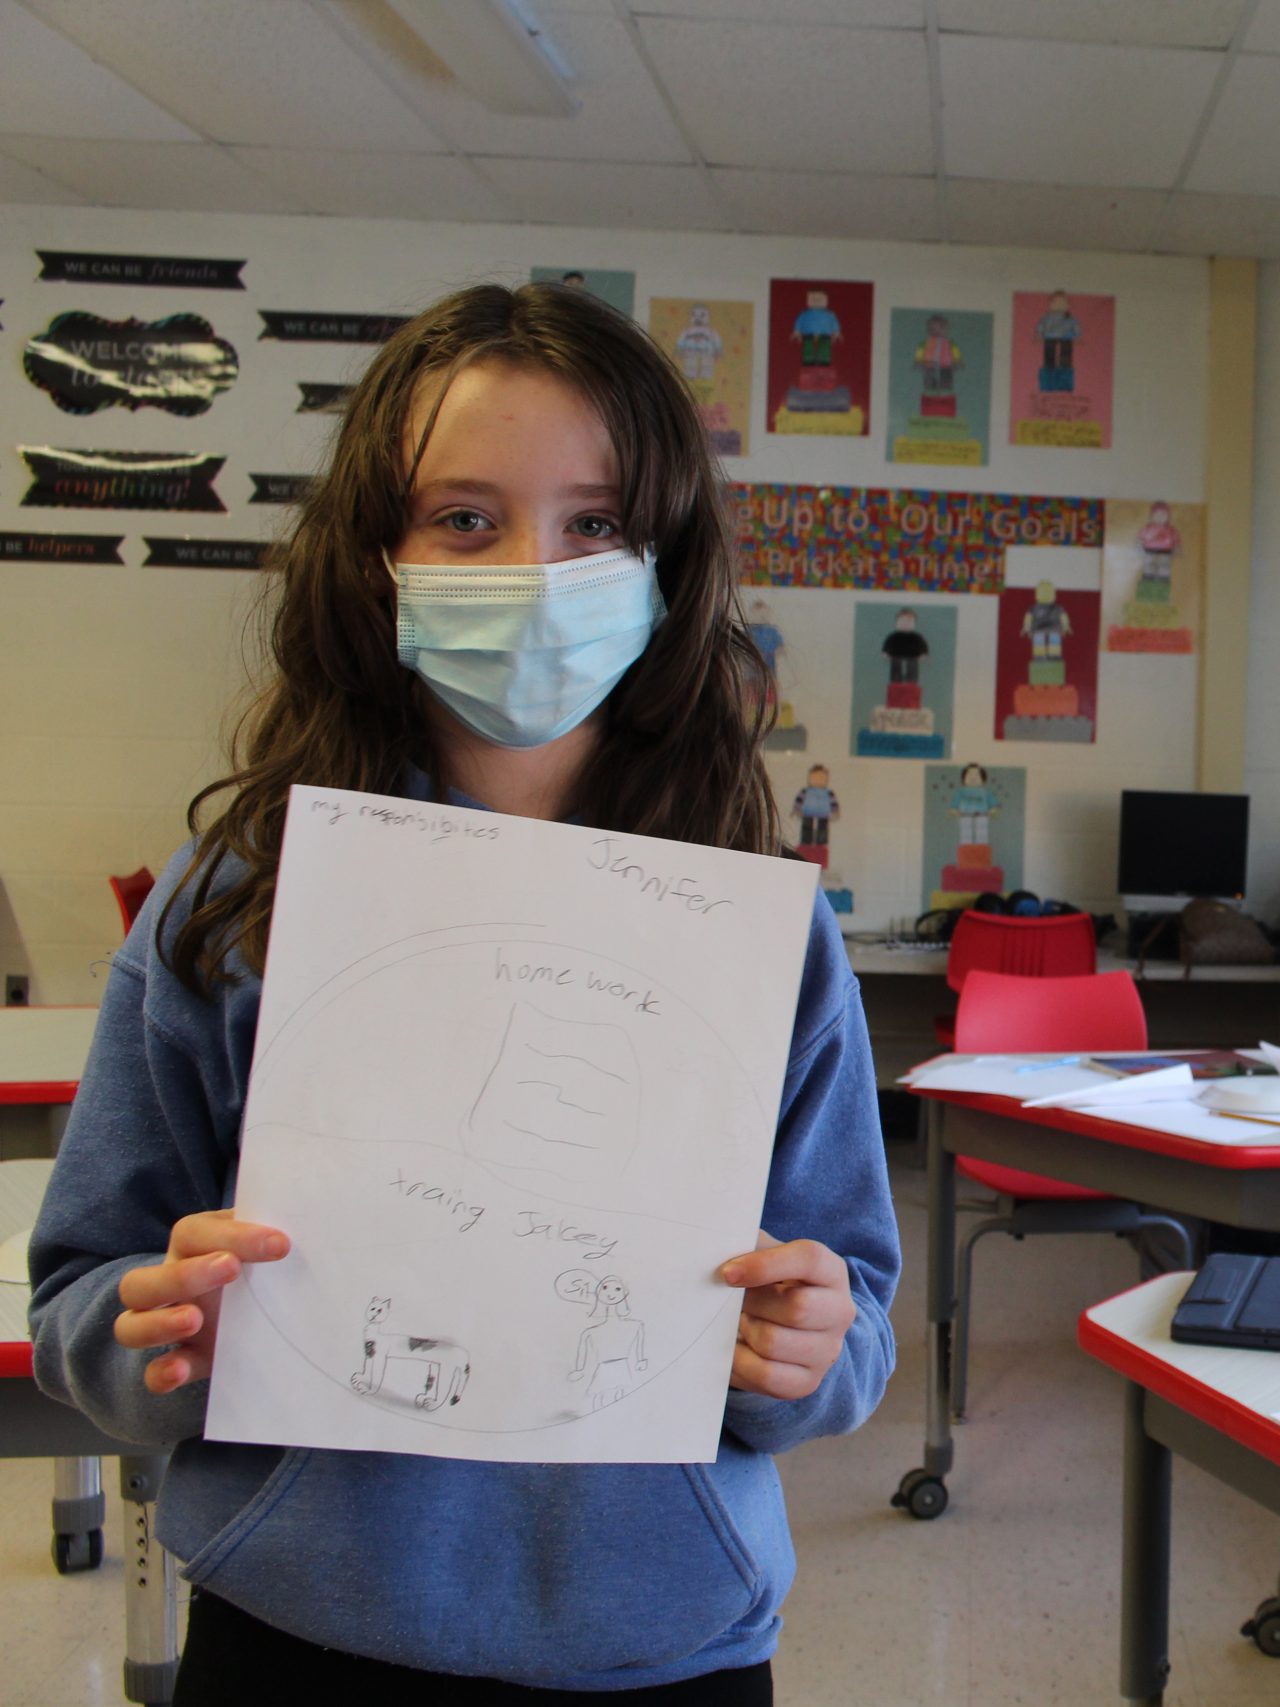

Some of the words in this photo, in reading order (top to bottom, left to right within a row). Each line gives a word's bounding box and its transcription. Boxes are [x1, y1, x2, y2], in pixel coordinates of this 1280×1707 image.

[65, 261, 87, 274] WE
[91, 262, 120, 275] CAN
[125, 264, 142, 276] BE
[149, 261, 218, 280] friends
[284, 321, 306, 333] WE
[309, 322, 339, 334] CAN
[54, 476, 191, 503] anything!
[764, 498, 813, 537] Up
[832, 503, 869, 533] to
[900, 503, 971, 537] Our
[991, 507, 1099, 544] Goals
[28, 539, 95, 558] helpers
[176, 547, 198, 560] WE
[202, 548, 231, 561] CAN
[768, 550, 842, 578] Brick
[311, 800, 350, 826] my
[586, 838, 735, 915] Jennifer
